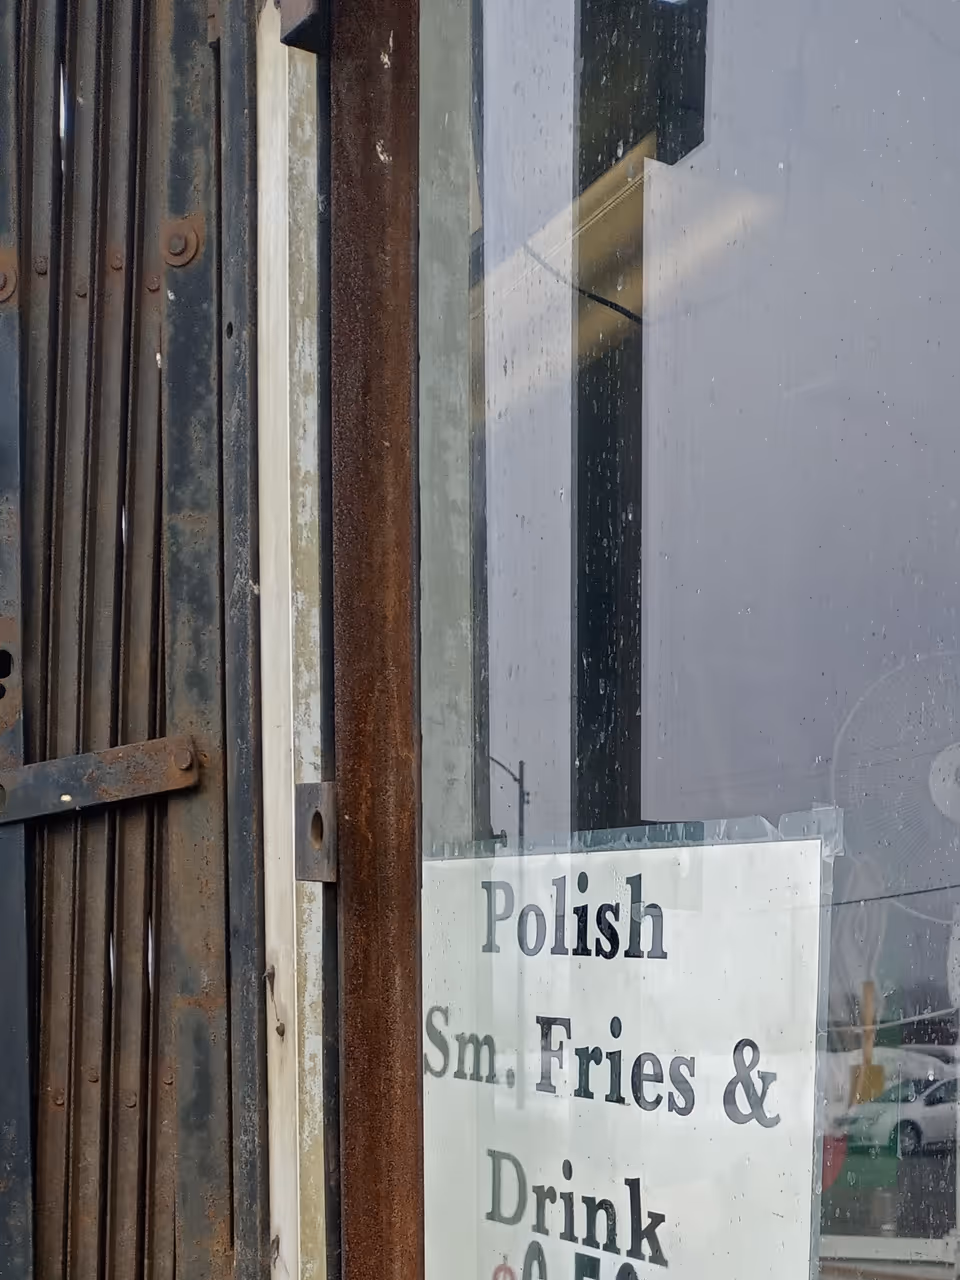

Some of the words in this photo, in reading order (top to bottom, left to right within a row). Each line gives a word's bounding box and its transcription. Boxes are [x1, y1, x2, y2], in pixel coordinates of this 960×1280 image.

[481, 872, 668, 960] Polish
[423, 1005, 515, 1088] Sm.
[535, 1016, 696, 1117] Fries
[722, 1038, 781, 1128] &
[486, 1149, 669, 1267] Drink
